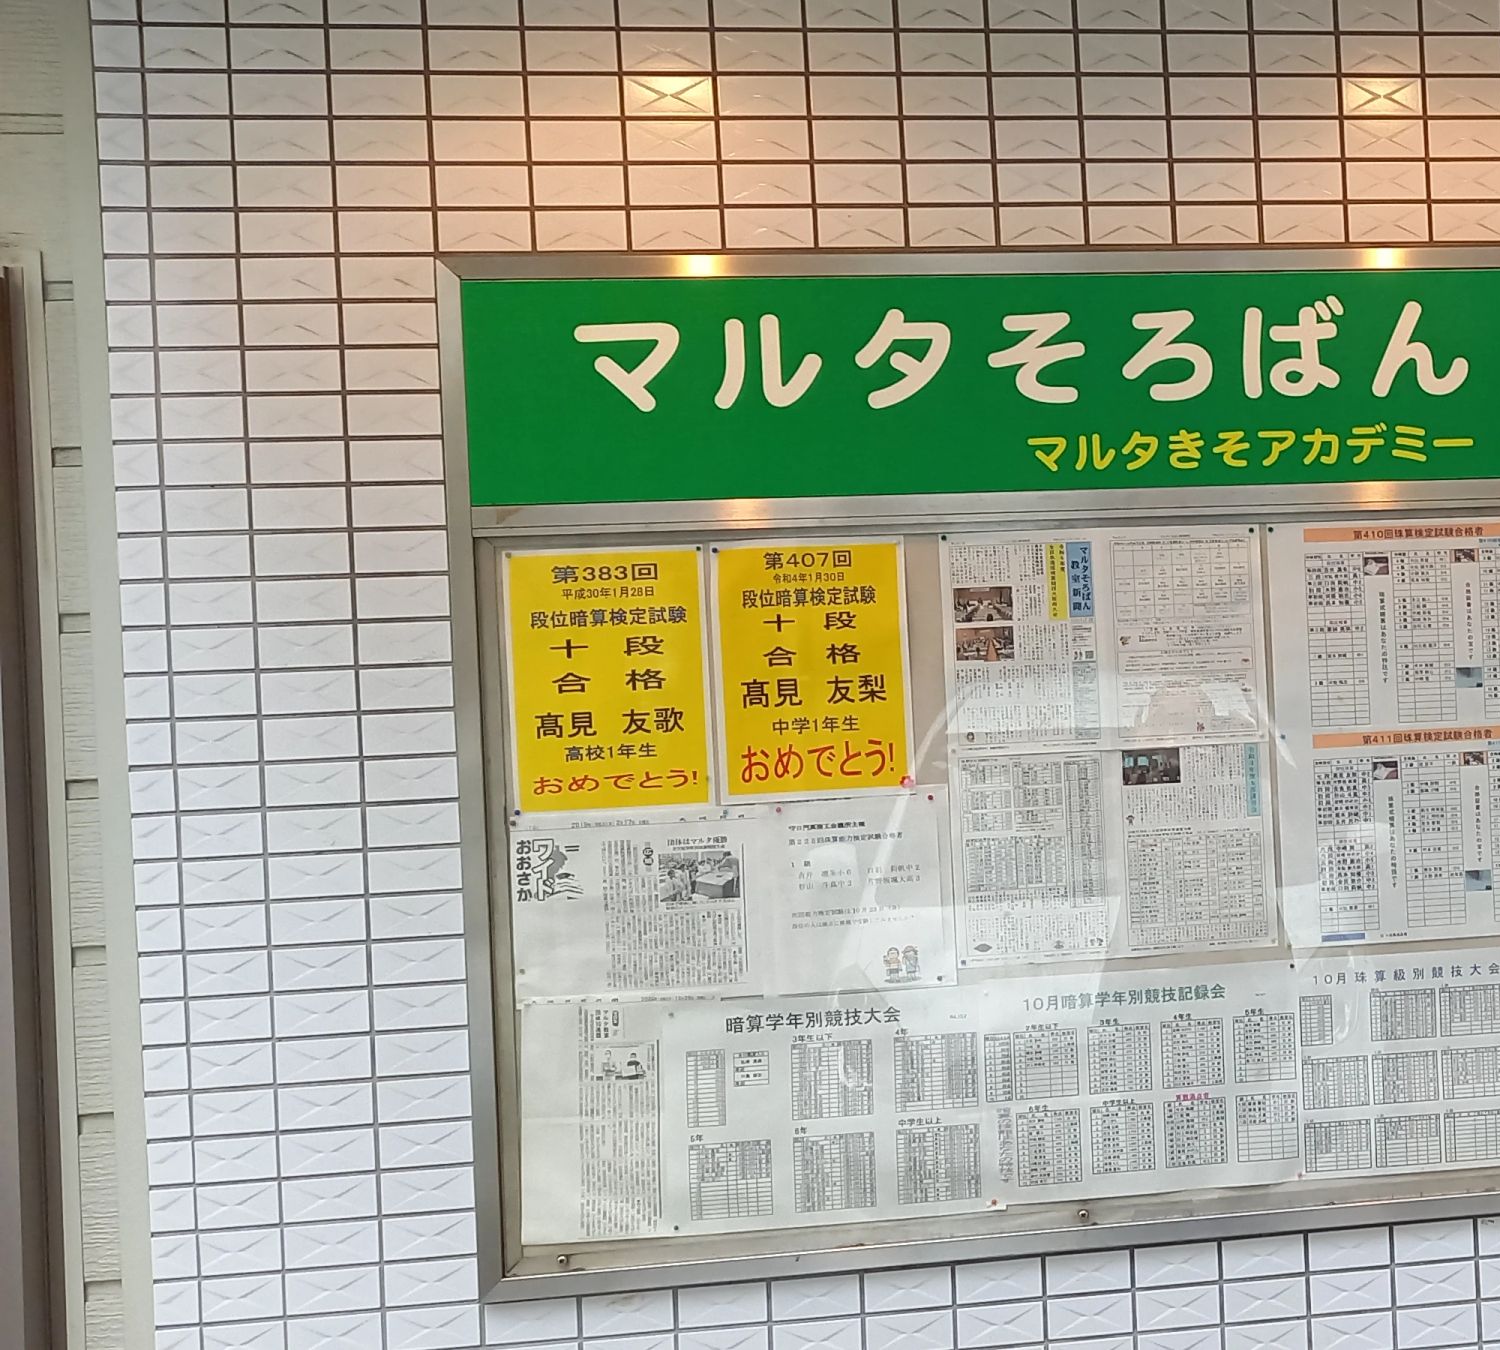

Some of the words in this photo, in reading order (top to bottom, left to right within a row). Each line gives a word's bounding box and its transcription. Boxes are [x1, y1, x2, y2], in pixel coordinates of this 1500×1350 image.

[573, 296, 1469, 413] マルタそろばん
[1026, 424, 1474, 475] マルタきそアカデミー
[1353, 526, 1484, 540] 第410回珠算検定試験合格者
[763, 549, 852, 571] 第407回
[551, 562, 659, 585] 第383回
[773, 571, 845, 584] 令和4年1月30日
[1080, 547, 1091, 610] マルタそろばん
[561, 585, 655, 600] 平成30年1月28日
[741, 585, 877, 609] 段位暗算検定試験
[530, 605, 688, 630] 段位暗算検定試験
[763, 611, 857, 633] 十段
[549, 635, 665, 659] 十段
[763, 642, 861, 668] 合格
[552, 668, 666, 695] 合格
[827, 674, 888, 703] 友梨
[622, 706, 685, 735] 友歌
[772, 714, 860, 736] 中学1年生
[1362, 729, 1493, 745] 第411回珠算検定試験合格者
[564, 742, 658, 763] 高校1年生
[741, 738, 896, 784] おめでとう!
[532, 769, 699, 797] おめでとう!
[516, 839, 533, 902] おおさか
[531, 838, 556, 901] ワイド
[1312, 963, 1500, 986] 10月珠算級別競技大会
[1023, 983, 1226, 1012] 10月暗算学年別競技記録会
[725, 1006, 901, 1034] 暗算学年別競技大会
[792, 1032, 833, 1043] 3年生以下
[898, 1117, 943, 1127] 中学生以上
